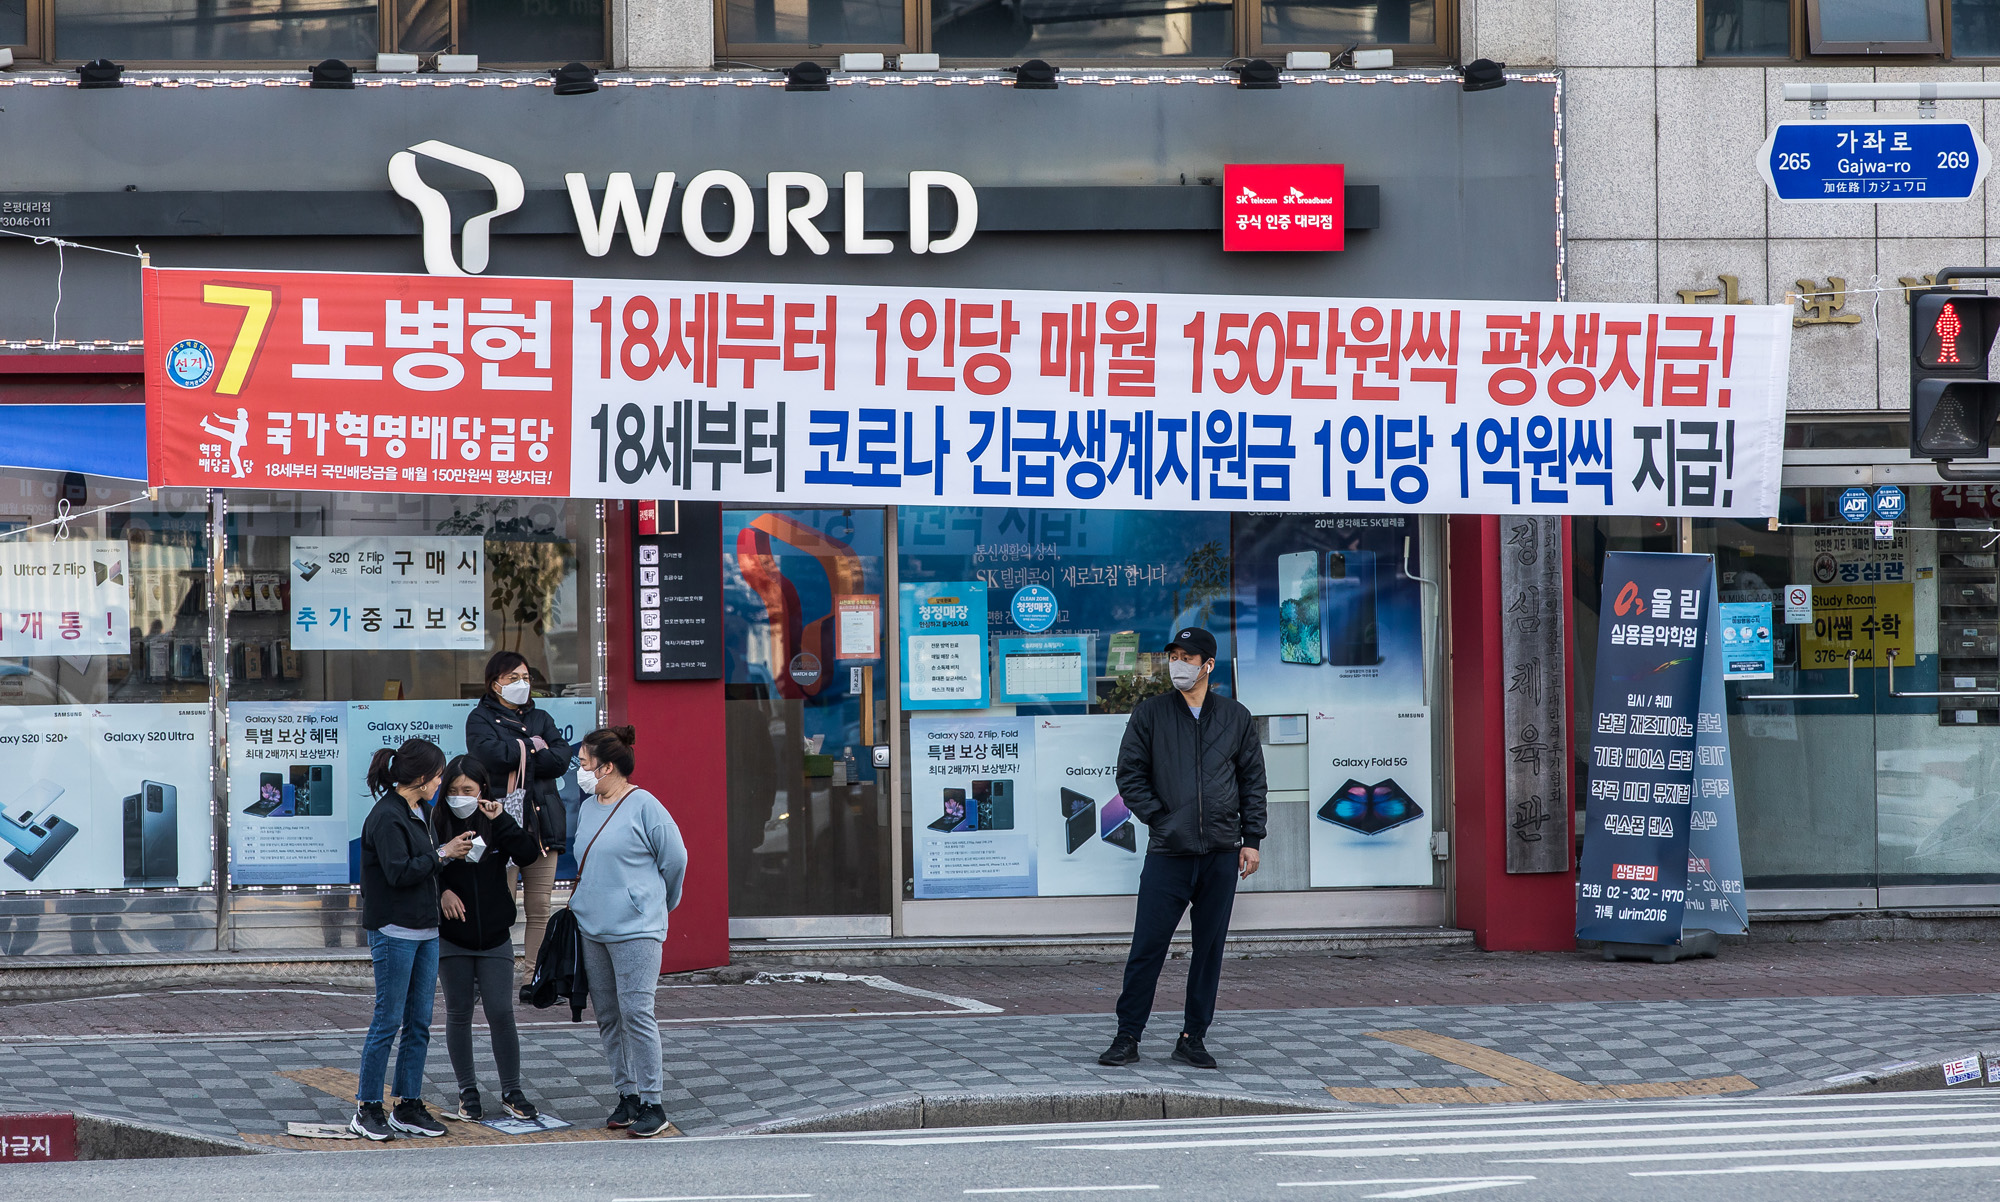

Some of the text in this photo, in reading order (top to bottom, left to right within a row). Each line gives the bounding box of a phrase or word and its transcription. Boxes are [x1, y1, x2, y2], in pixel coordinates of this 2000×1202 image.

[1836, 130, 1912, 153] 가좌로
[1778, 153, 1811, 171] 265
[1838, 158, 1911, 177] Gajwa-ro
[1937, 151, 1970, 169] 269
[1824, 181, 1860, 194] 加佐路
[1868, 180, 1927, 193] カジュワロ
[3, 201, 51, 213] 은평대리점
[1236, 195, 1248, 204] SK
[1283, 195, 1295, 204] SK
[564, 169, 978, 257] WORLD
[1236, 214, 1332, 230] 공식 인증 대리점
[203, 284, 274, 395] 7
[292, 298, 552, 392] 노병현
[590, 292, 1736, 408] 18세부터 1인당 매월 150만원씩 평생지급!
[176, 357, 203, 373] 선거
[267, 411, 553, 462] 국가혁명배당금당
[199, 444, 221, 458] 혁명
[591, 399, 1736, 508] 18세부터 코로나 긴급생계지원금 1인당 1억원씩 지급!
[198, 459, 230, 473] 배당금
[265, 463, 553, 486] 18세부터 국민배당금을 매월 150만원씩 평생지급!
[1844, 498, 1867, 511] ADT
[1878, 496, 1901, 508] ADT
[1314, 519, 1334, 529] 20번
[1336, 518, 1368, 528] 생각해도
[328, 552, 384, 564] S20 Z Flip
[975, 543, 1061, 562] 통신생활의 상식,
[14, 562, 86, 579] Ultra Z Flip
[360, 565, 382, 575] Fold
[1839, 562, 1904, 583] 정심관
[1651, 588, 1700, 620] 울림
[1729, 594, 1753, 602] MUSIC
[1812, 594, 1876, 607] Study Room
[919, 605, 968, 620] 청정매장
[1017, 602, 1053, 613] 청정매장
[1815, 614, 1901, 641] 이쌤 수학
[1611, 624, 1698, 648] 실용음악학원
[1507, 517, 1550, 842] 정심체육관
[1627, 694, 1673, 708] 입시 취미
[245, 714, 338, 725] Galaxy S20, Z Flip, Fold
[367, 721, 409, 733] Galaxy
[1598, 713, 1693, 737] 보컬 재즈피아노
[22, 734, 39, 743] S20
[46, 734, 68, 743] S20+
[104, 731, 195, 744] Galaxy S20 Ultra
[244, 728, 338, 745] 특별 보상 혜택
[382, 735, 392, 745] 단
[928, 730, 1018, 741] Galaxy S20, Z Flip, Fold
[245, 749, 339, 760] 최대 2배까지 보상받자!
[928, 743, 1018, 760] 특별 보상 혜택
[1594, 746, 1693, 771] 기타 베이스 드럼
[929, 763, 1020, 775] 최대 2배까지 보상받자!
[1333, 757, 1408, 768] Galaxy Fold 5G
[1066, 766, 1102, 778] Galaxy
[1105, 766, 1111, 775] Z
[1592, 780, 1691, 804] 작곡 미디 뮤지컬
[1605, 814, 1673, 838] 색소폰 댄스
[1616, 865, 1655, 880] 상담문의
[1582, 884, 1602, 898] 전화
[1595, 905, 1667, 922] 카톡 ulrim2016
[1945, 1062, 1965, 1075] 카드
